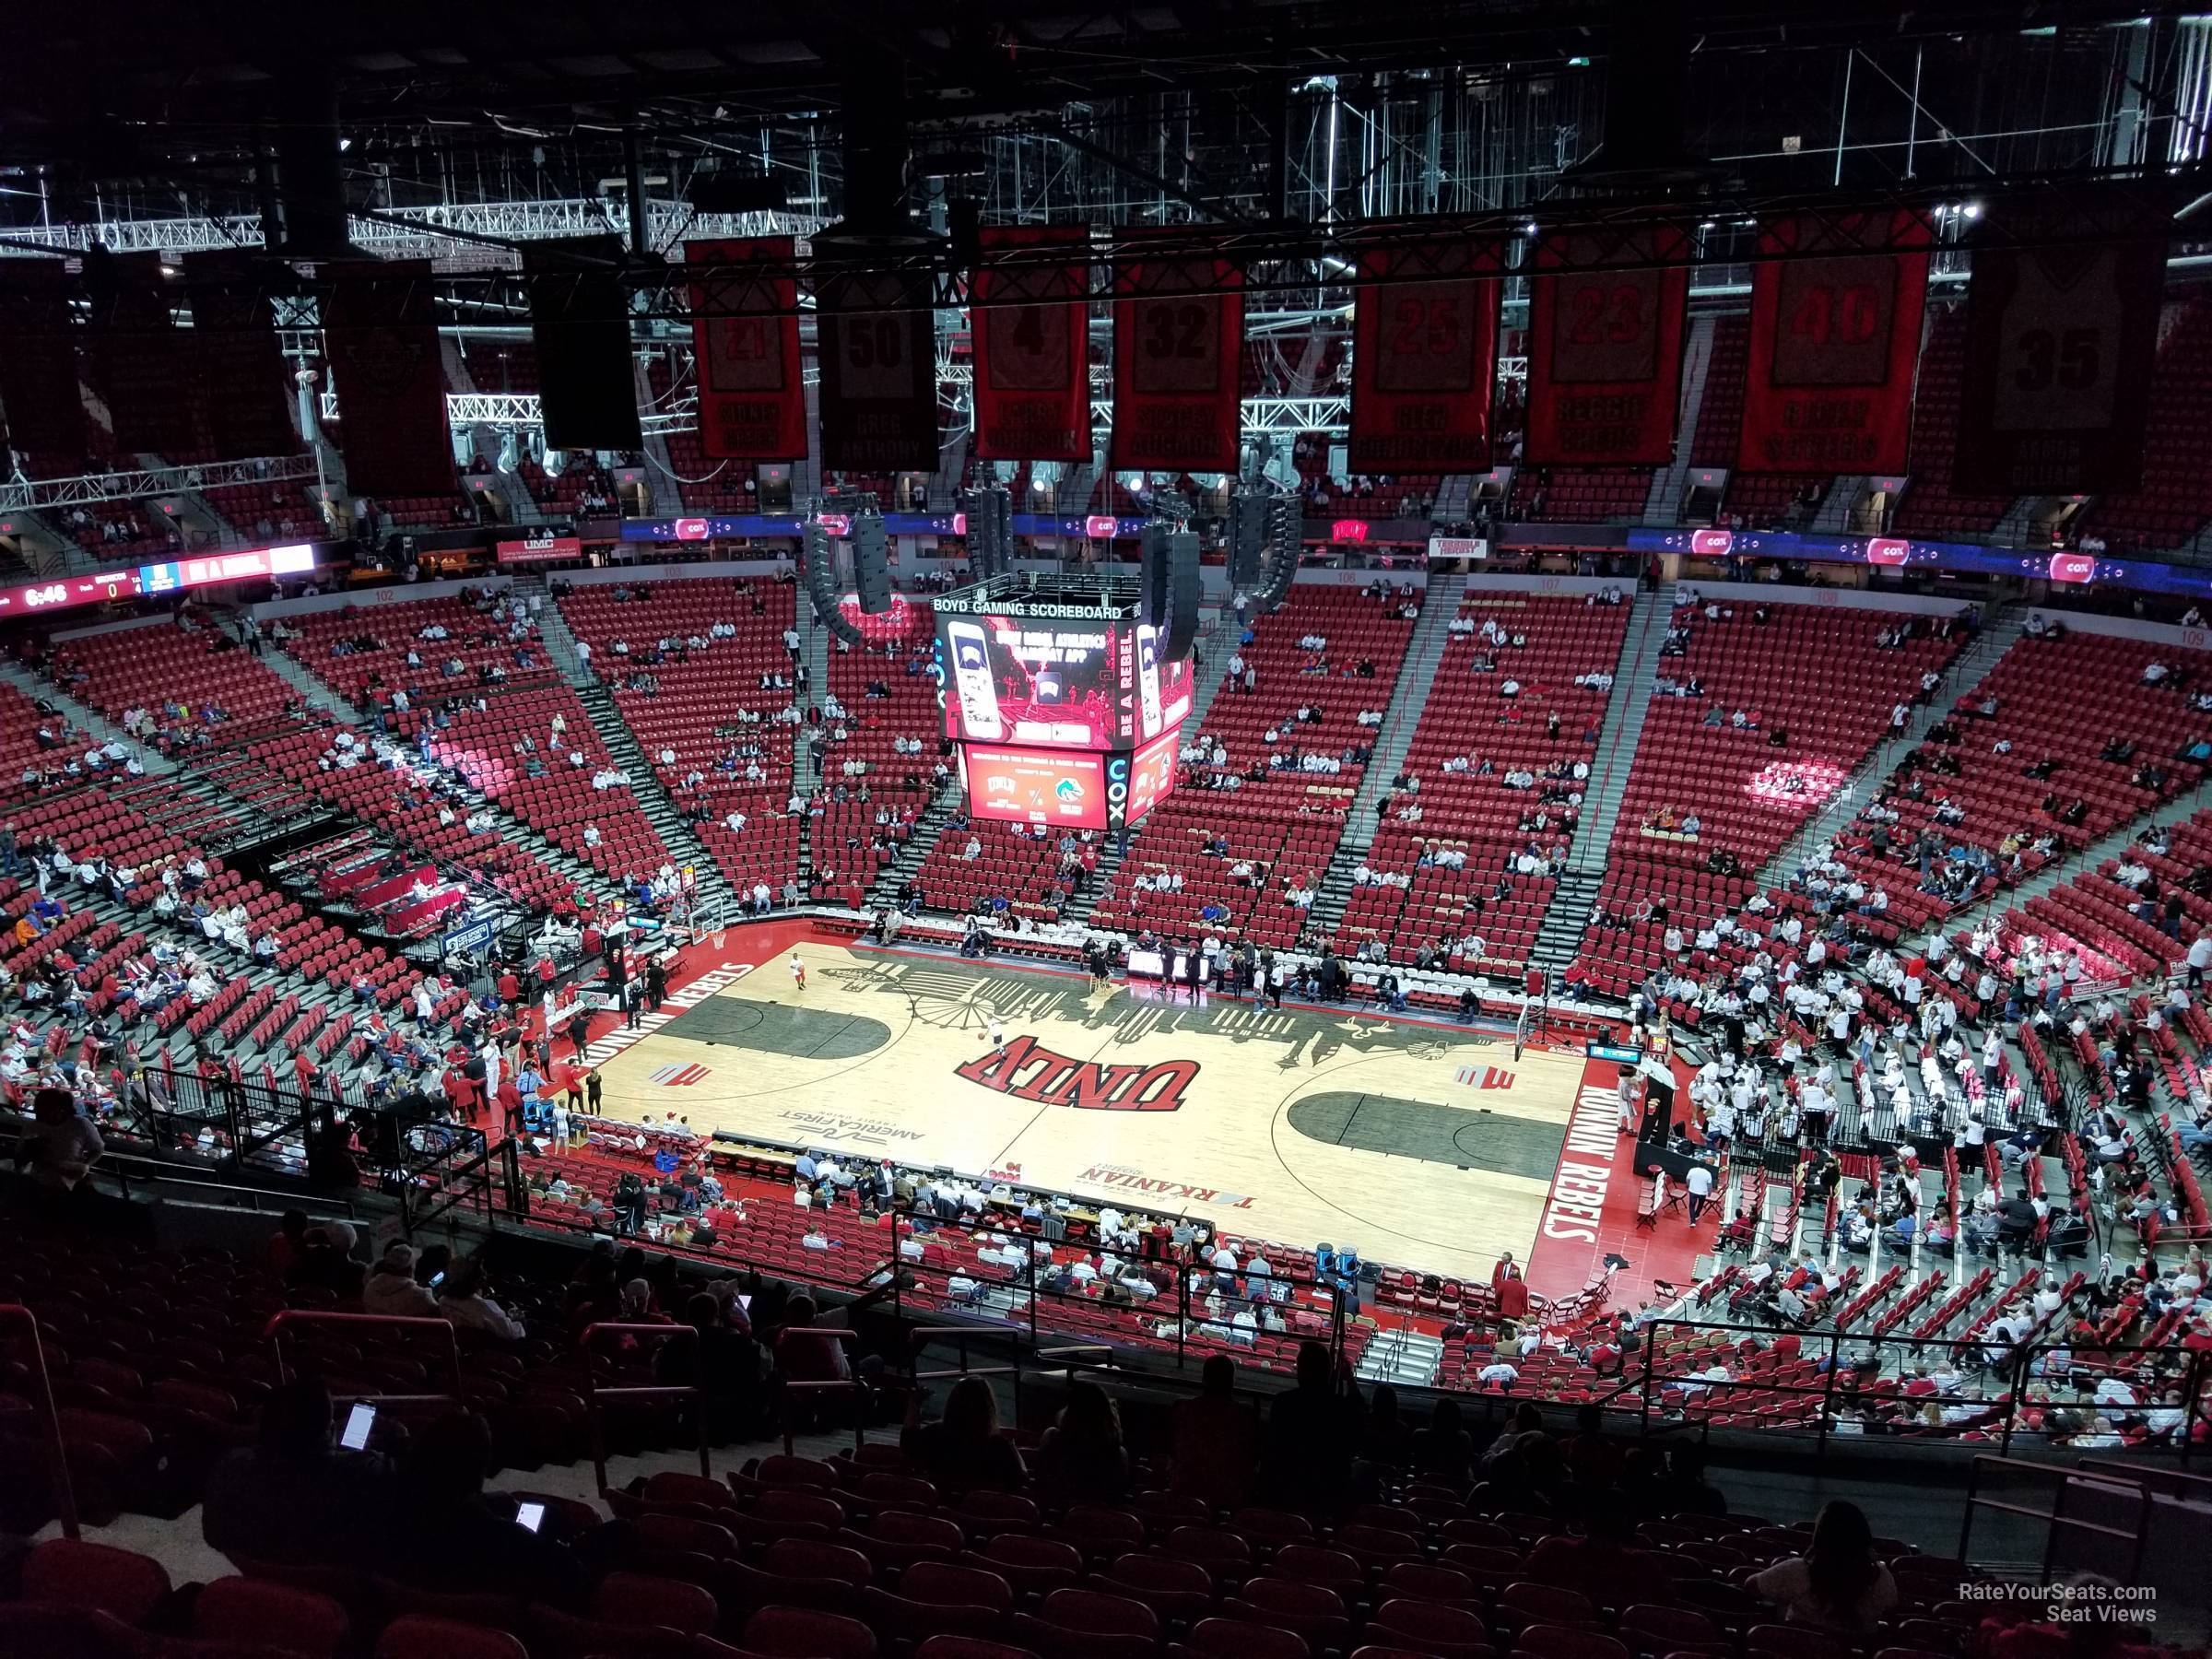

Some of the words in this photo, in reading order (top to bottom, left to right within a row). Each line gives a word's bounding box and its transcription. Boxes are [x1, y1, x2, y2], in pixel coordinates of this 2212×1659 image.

[1570, 284, 1642, 345] 23
[1791, 284, 1879, 346] 40
[724, 317, 767, 360] 21
[1013, 303, 1044, 356] 4
[1146, 305, 1206, 359] 32
[1392, 298, 1459, 356] 25
[849, 317, 901, 368] 50
[2016, 327, 2100, 392] 35
[856, 413, 901, 436] GREG
[841, 439, 921, 463] ANTHONY
[524, 540, 553, 549] UMC
[664, 567, 681, 577] 103
[108, 583, 117, 598] 0
[376, 590, 394, 602] 102
[1541, 579, 1560, 590] 107
[934, 598, 968, 613] BOYD
[972, 600, 1025, 615] GAMING
[1030, 604, 1122, 619] SCOREBOARD
[2183, 630, 2204, 645] 109
[1120, 694, 1133, 709] A
[1120, 714, 1133, 736] BE
[1108, 759, 1127, 821] COX
[560, 1011, 677, 1068] RUNNIN
[954, 1034, 1201, 1112] UNLV
[777, 1111, 835, 1125] FIRST
[839, 1120, 925, 1140] AMERICA
[1566, 1085, 1618, 1161] RUNNIN'
[1543, 1160, 1611, 1243] REBELS
[1270, 1287, 1285, 1301] 58
